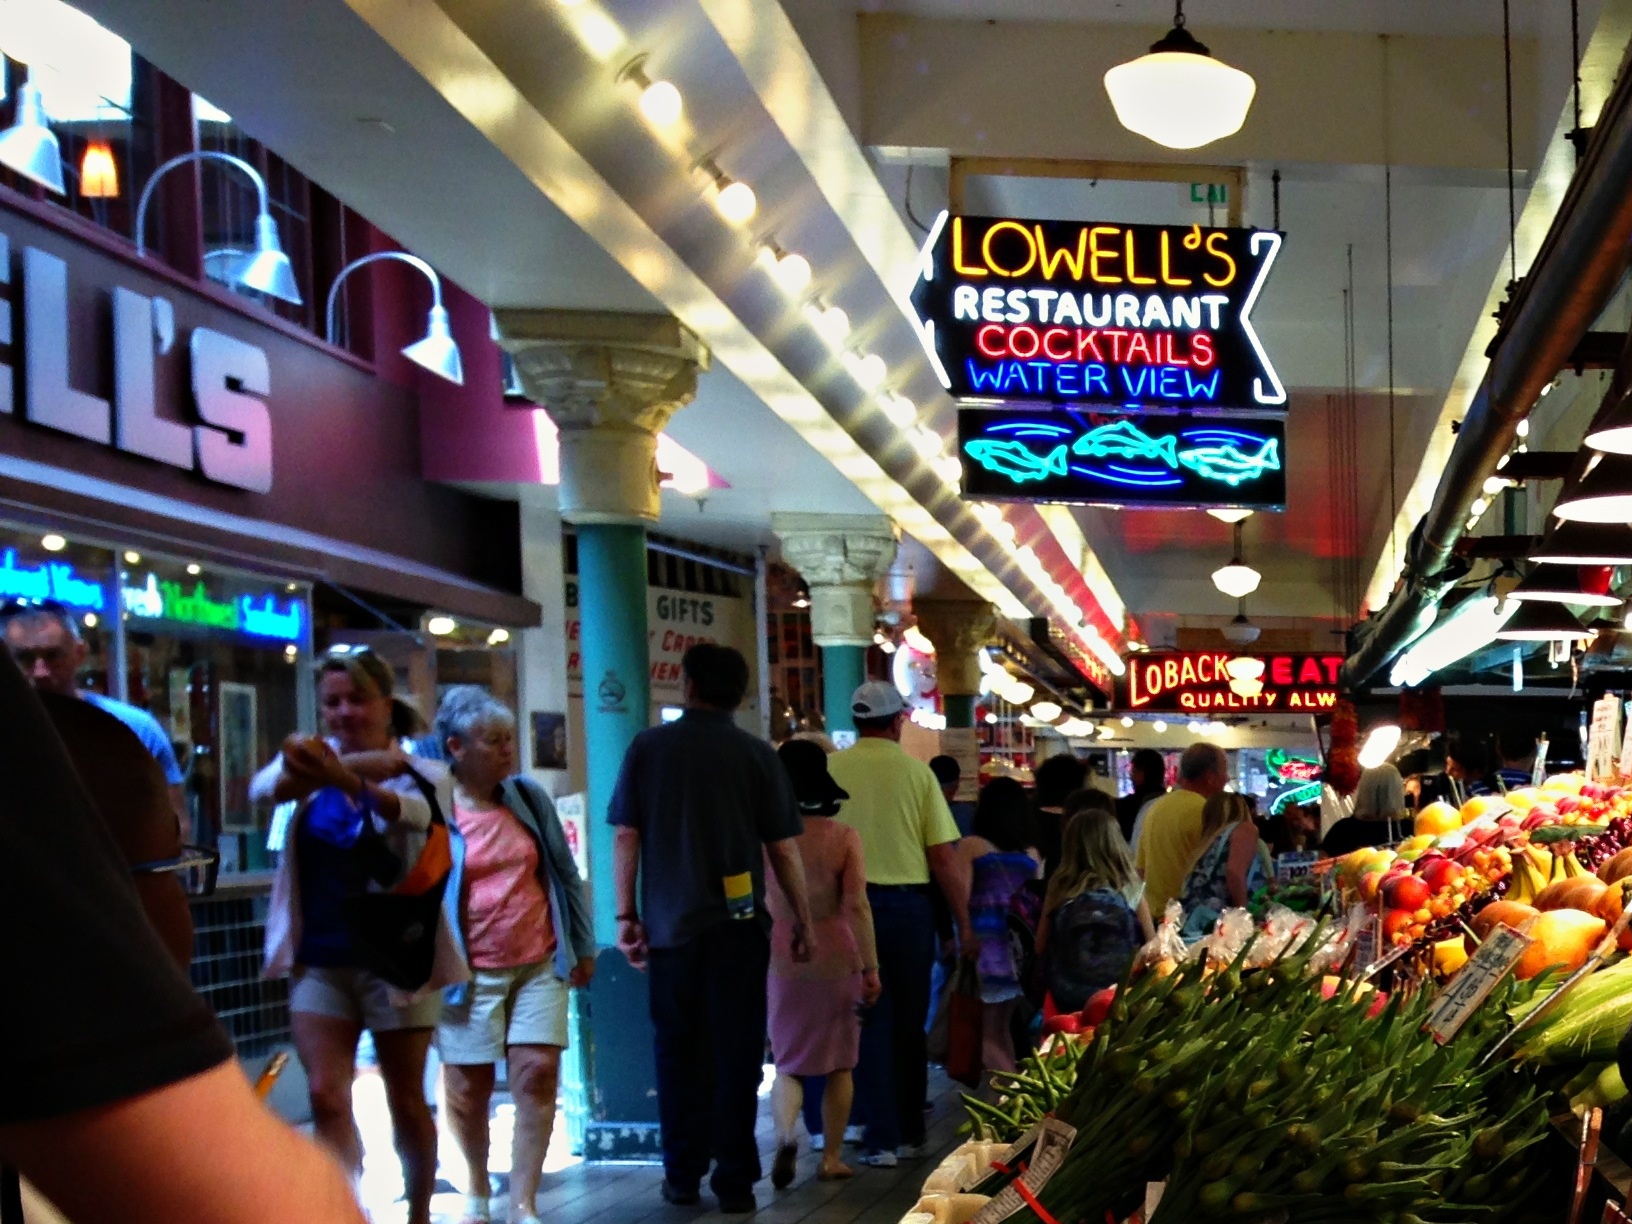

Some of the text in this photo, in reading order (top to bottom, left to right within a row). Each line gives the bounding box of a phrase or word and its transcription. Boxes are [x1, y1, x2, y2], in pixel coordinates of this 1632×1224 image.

[952, 216, 1237, 287] LOWELL'S
[953, 284, 1230, 331] RESTAURANT
[977, 324, 1216, 368] COCKTAILS
[967, 358, 1221, 400] WATER VIEW
[656, 594, 715, 627] GIFTS
[1180, 691, 1336, 709] QUALITY ALW
